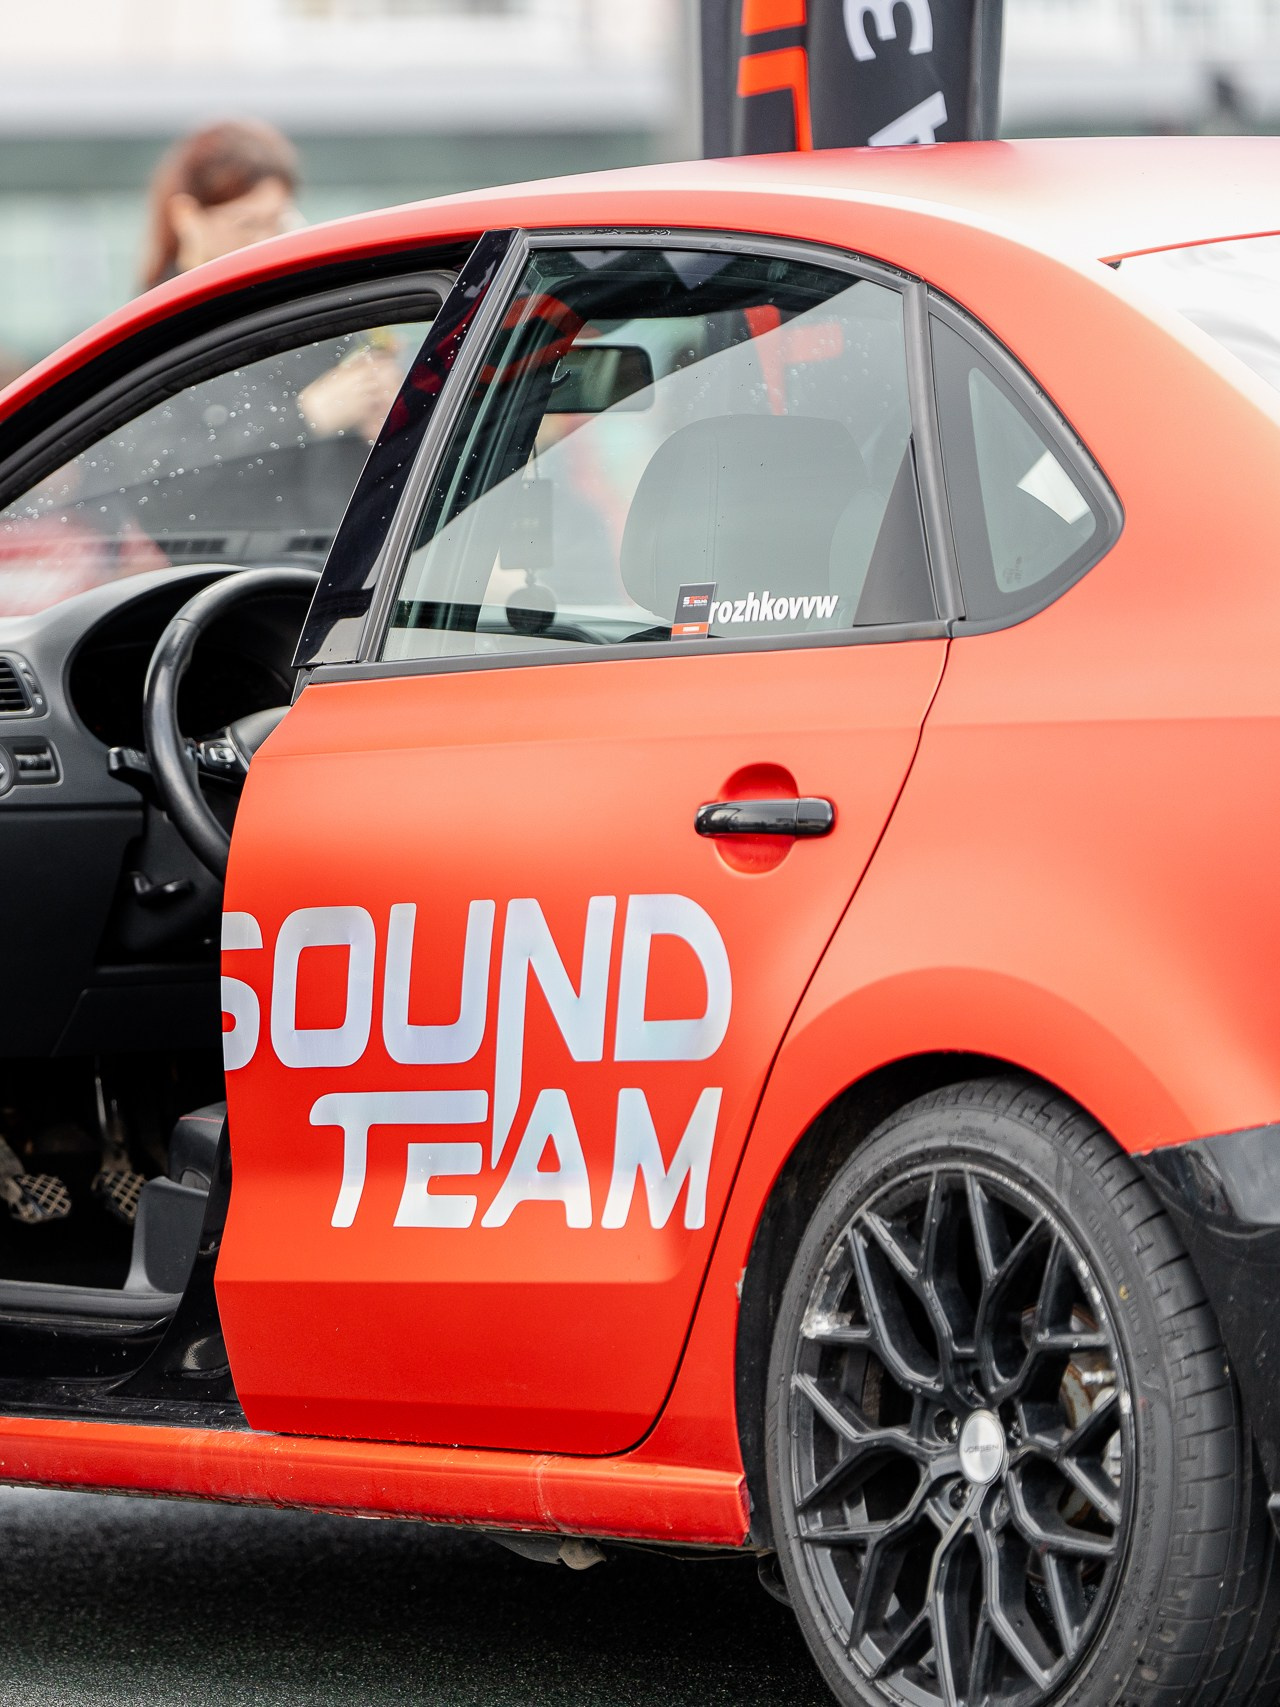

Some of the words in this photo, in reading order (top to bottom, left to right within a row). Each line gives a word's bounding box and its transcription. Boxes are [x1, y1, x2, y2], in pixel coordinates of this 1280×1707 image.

[708, 591, 838, 624] rozhkovvw
[221, 894, 732, 1169] SOUND
[309, 1087, 723, 1229] TEAM
